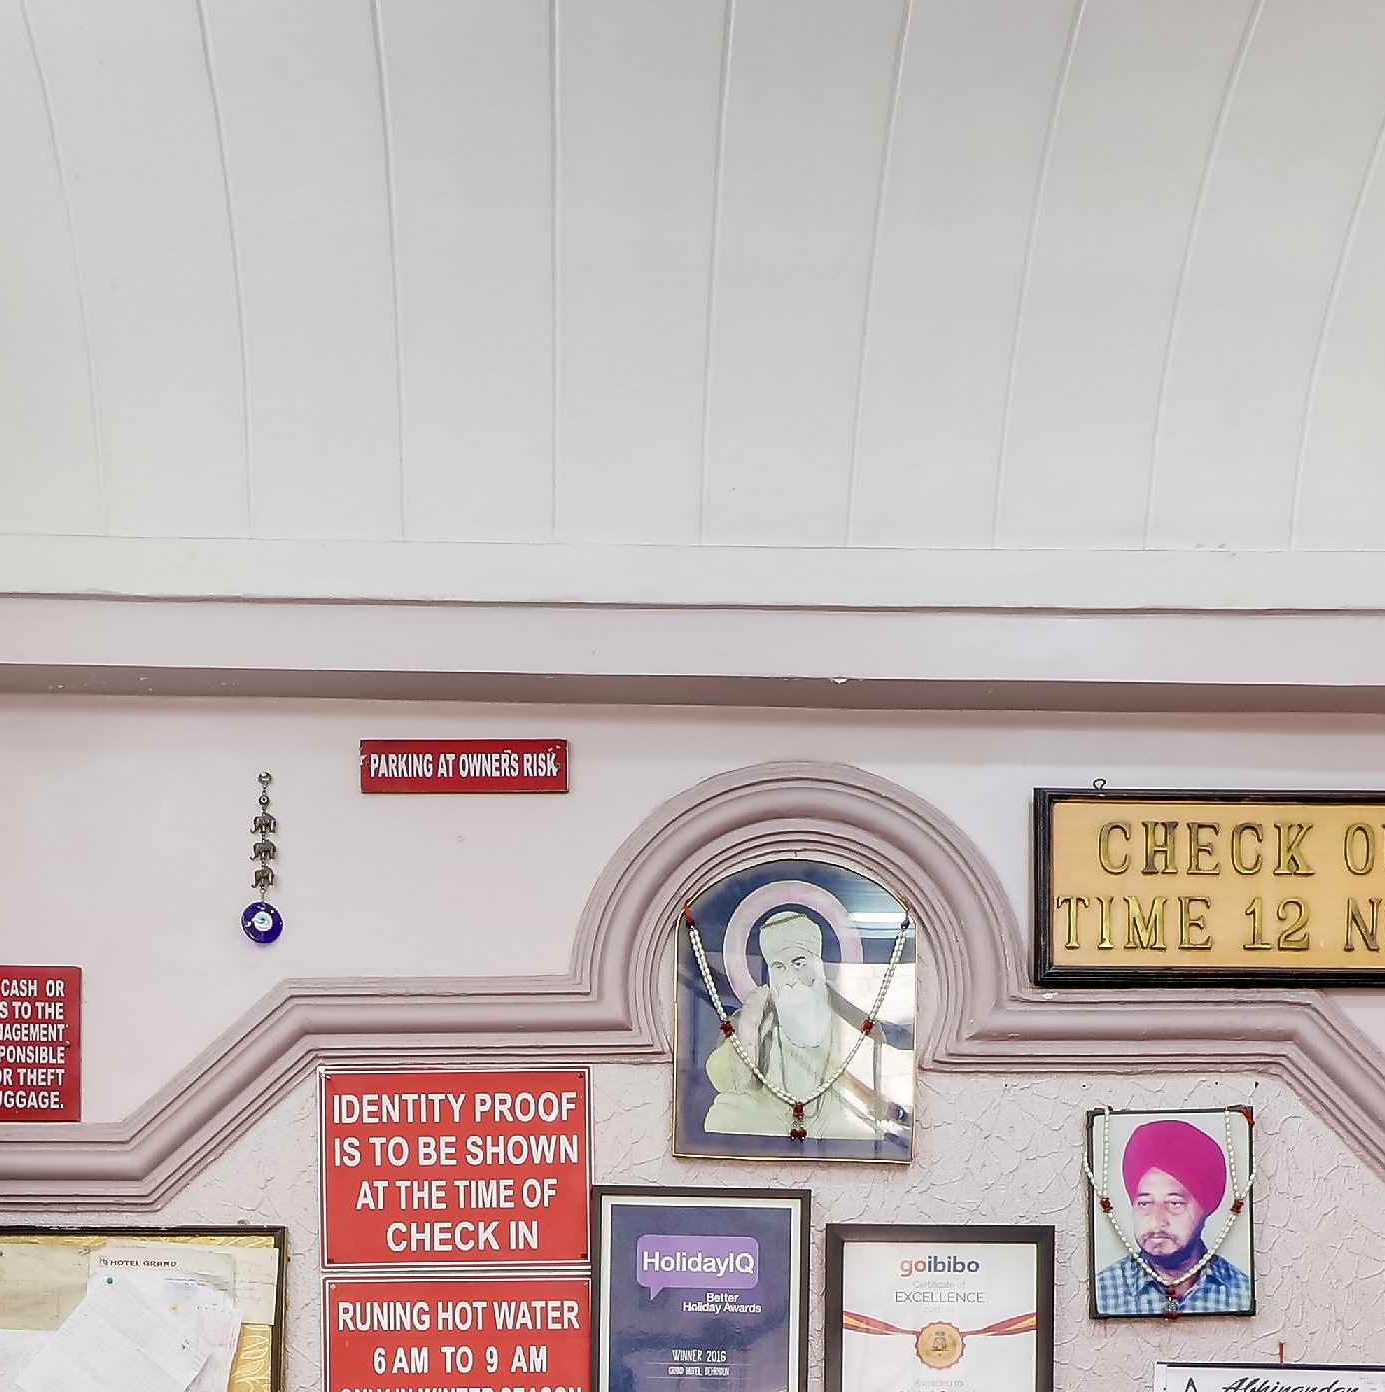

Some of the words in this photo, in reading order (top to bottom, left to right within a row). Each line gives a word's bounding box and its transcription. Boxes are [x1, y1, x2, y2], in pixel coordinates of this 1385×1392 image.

[371, 754, 433, 777] PARKING
[437, 754, 455, 777] AT
[524, 753, 557, 776] RISK
[1098, 821, 1315, 876] CHECK
[1056, 895, 1213, 951] TIME
[1242, 897, 1309, 950] 12
[1, 980, 37, 996] CASH
[46, 980, 64, 997] OR
[13, 1002, 32, 1019] TO
[35, 1002, 63, 1020] THE
[17, 1069, 65, 1086] THEFT
[333, 1093, 465, 1123] IDENTITY
[474, 1091, 577, 1122] PROOF
[334, 1137, 361, 1166] IS
[368, 1136, 408, 1166] TO
[418, 1136, 457, 1166] BE
[466, 1135, 579, 1165] SHOWN
[355, 1180, 388, 1210] AT
[396, 1180, 446, 1210] THE
[454, 1179, 514, 1209] TIME
[522, 1178, 557, 1208] OF
[387, 1221, 499, 1251] CHECK
[510, 1221, 538, 1249] IN
[643, 1251, 754, 1276] HolidayIQ
[900, 1256, 979, 1277] goibibo
[683, 1302, 721, 1314] Holiday
[723, 1303, 761, 1313] Awards
[706, 1293, 739, 1302] Better
[895, 1292, 984, 1303] EXCELLENCE
[338, 1301, 430, 1331] RUNING
[438, 1301, 487, 1330] HOT
[493, 1300, 580, 1330] WATER
[373, 1347, 386, 1374] 6
[392, 1347, 428, 1373] AM
[441, 1346, 473, 1373] TO
[486, 1346, 498, 1373] 9
[511, 1346, 547, 1373] AM
[672, 1349, 702, 1361] WINNER
[706, 1350, 726, 1362] 2016
